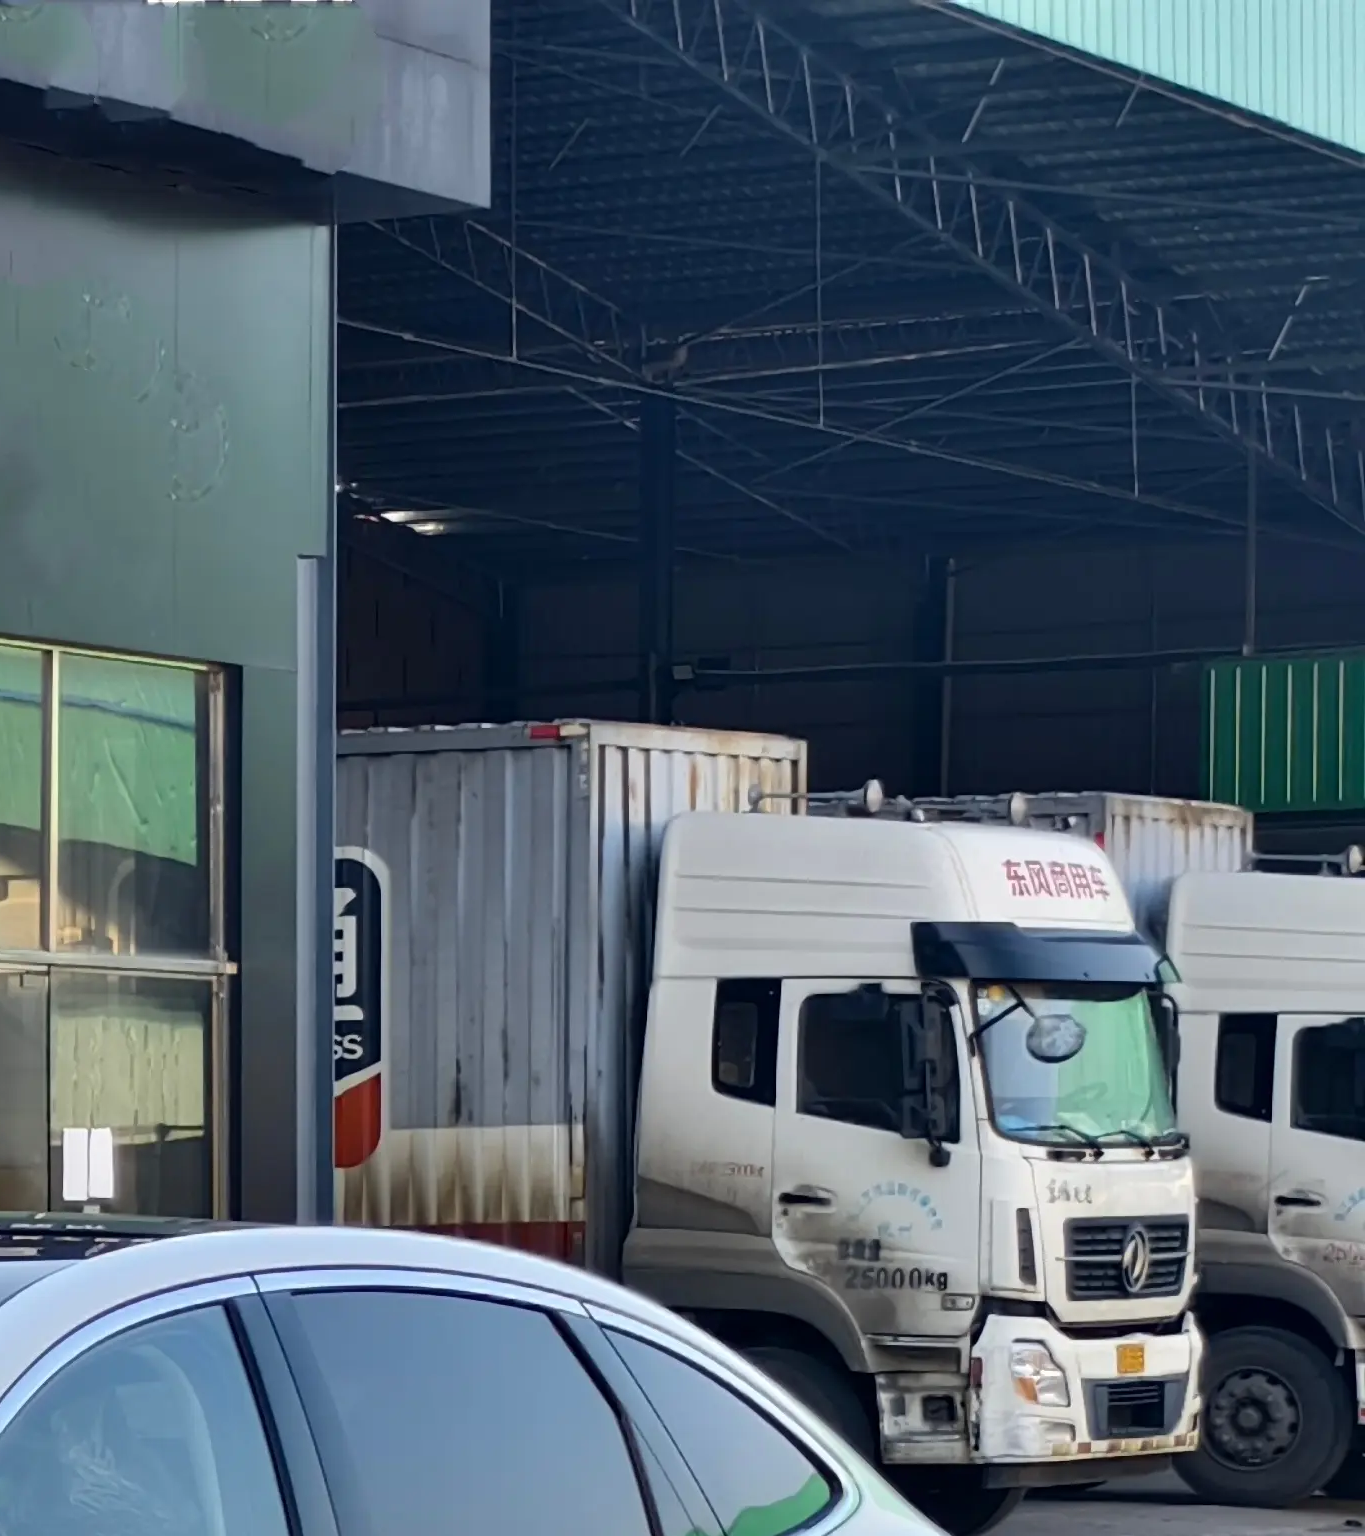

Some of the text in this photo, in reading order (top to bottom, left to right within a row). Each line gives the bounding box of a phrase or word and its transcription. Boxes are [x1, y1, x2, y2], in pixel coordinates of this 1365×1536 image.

[1002, 859, 1110, 901] 东风商用车
[845, 1267, 949, 1292] 25000kg
